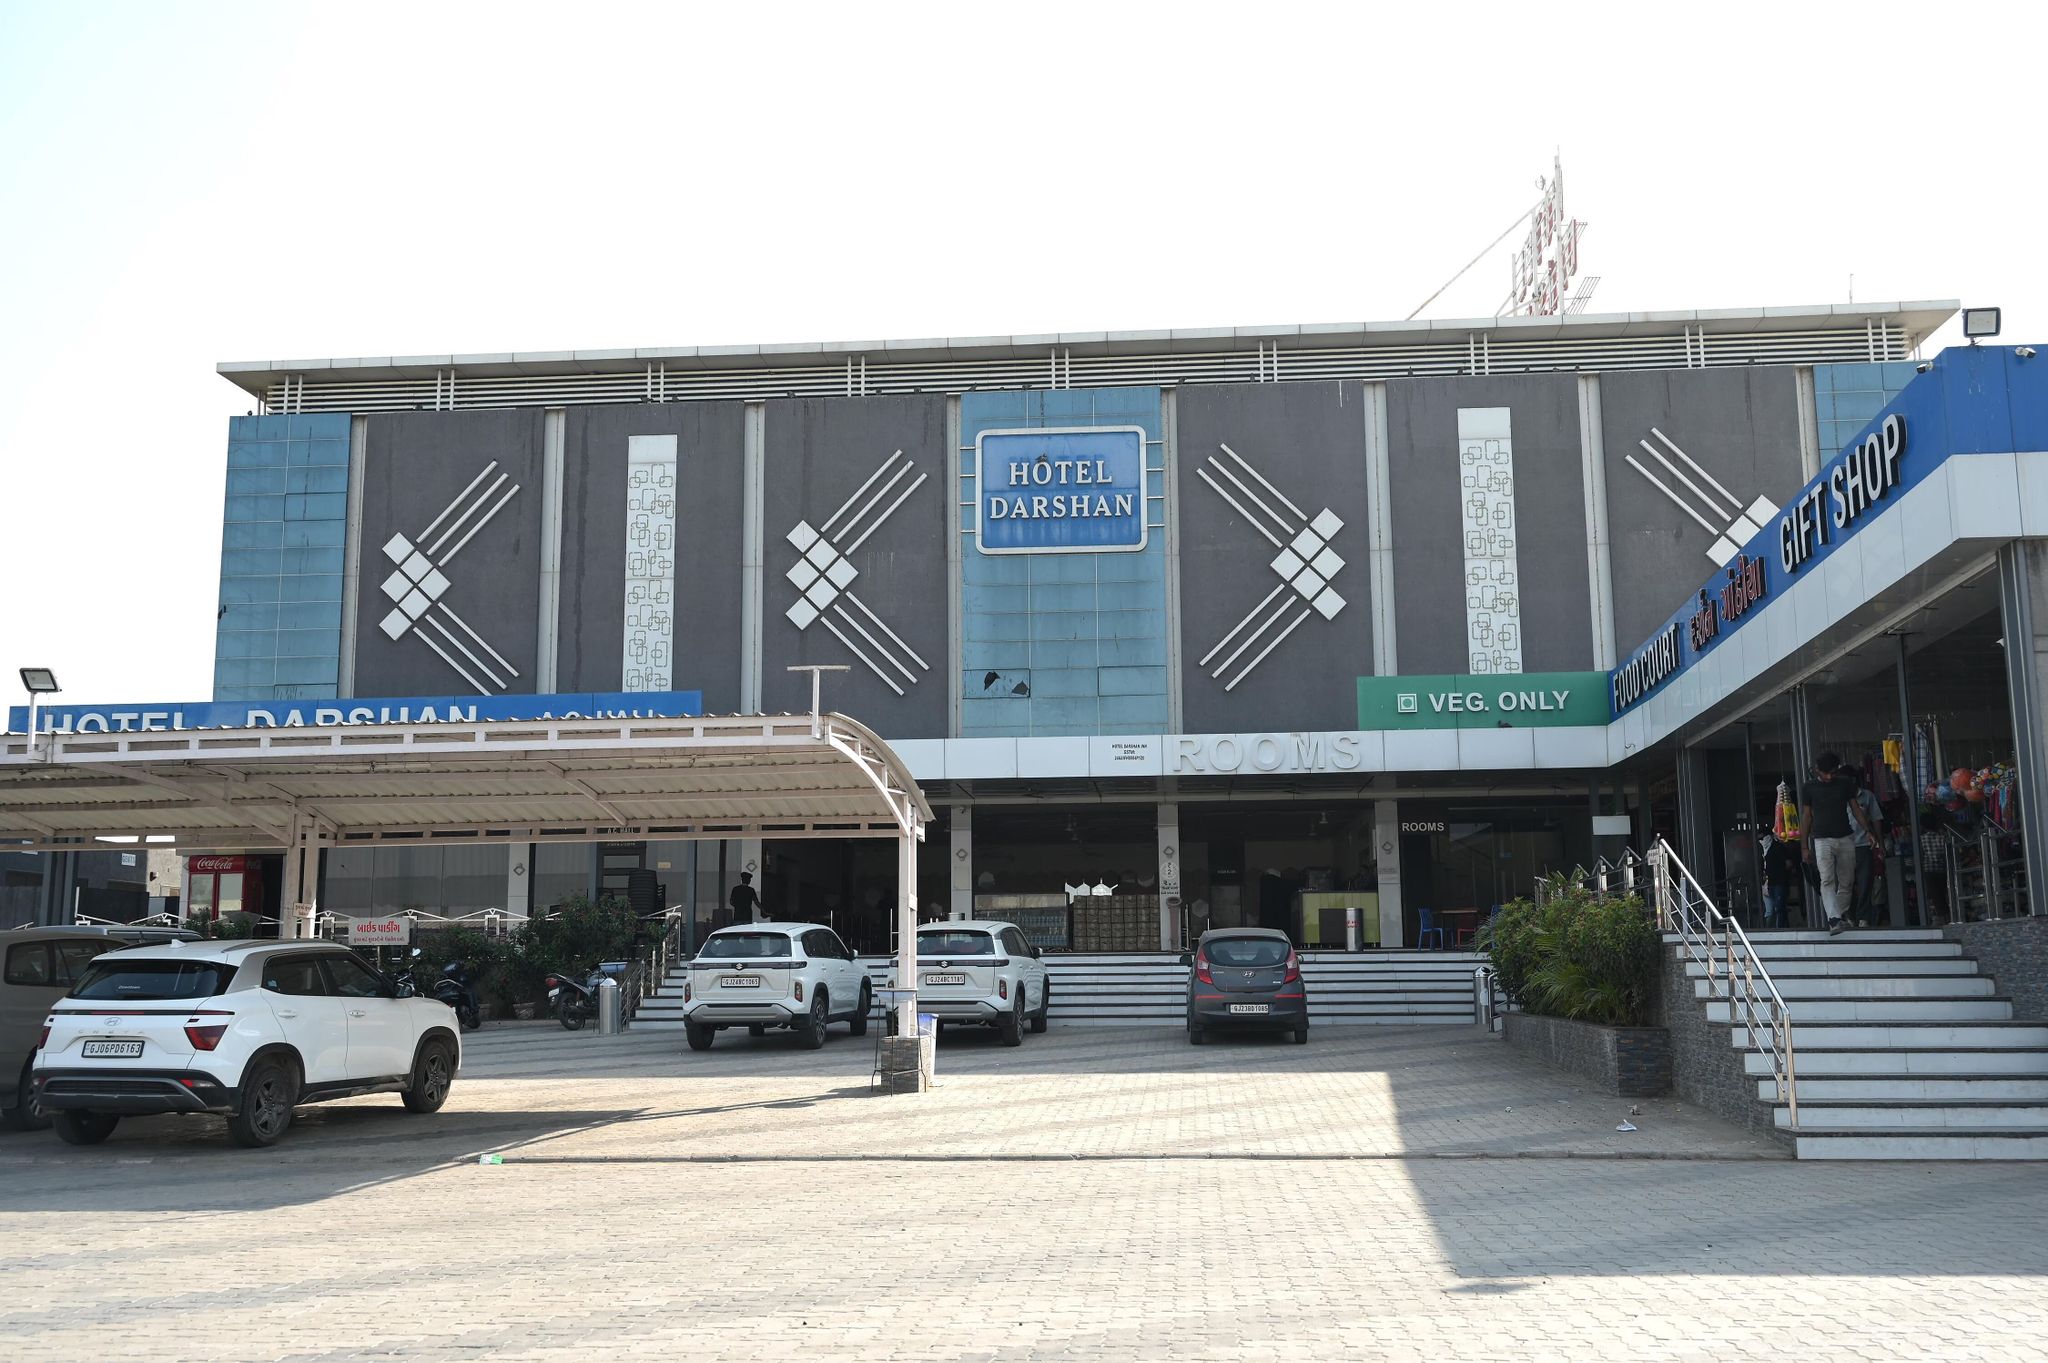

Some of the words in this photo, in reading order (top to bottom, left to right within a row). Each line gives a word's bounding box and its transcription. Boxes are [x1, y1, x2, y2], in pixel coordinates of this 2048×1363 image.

[1009, 460, 1112, 485] HOTEL
[1780, 481, 1829, 574] GIFT
[1831, 413, 1907, 529] SHOP
[990, 494, 1132, 519] DARSHAN
[1613, 658, 1641, 713] FOOD
[1641, 622, 1679, 692] COURT
[1428, 692, 1490, 712] VEG.
[1498, 690, 1570, 711] ONLY
[1173, 732, 1361, 772] ROOMS
[1402, 822, 1445, 832] ROOMS
[89, 1043, 140, 1054] GJ06PD6163
